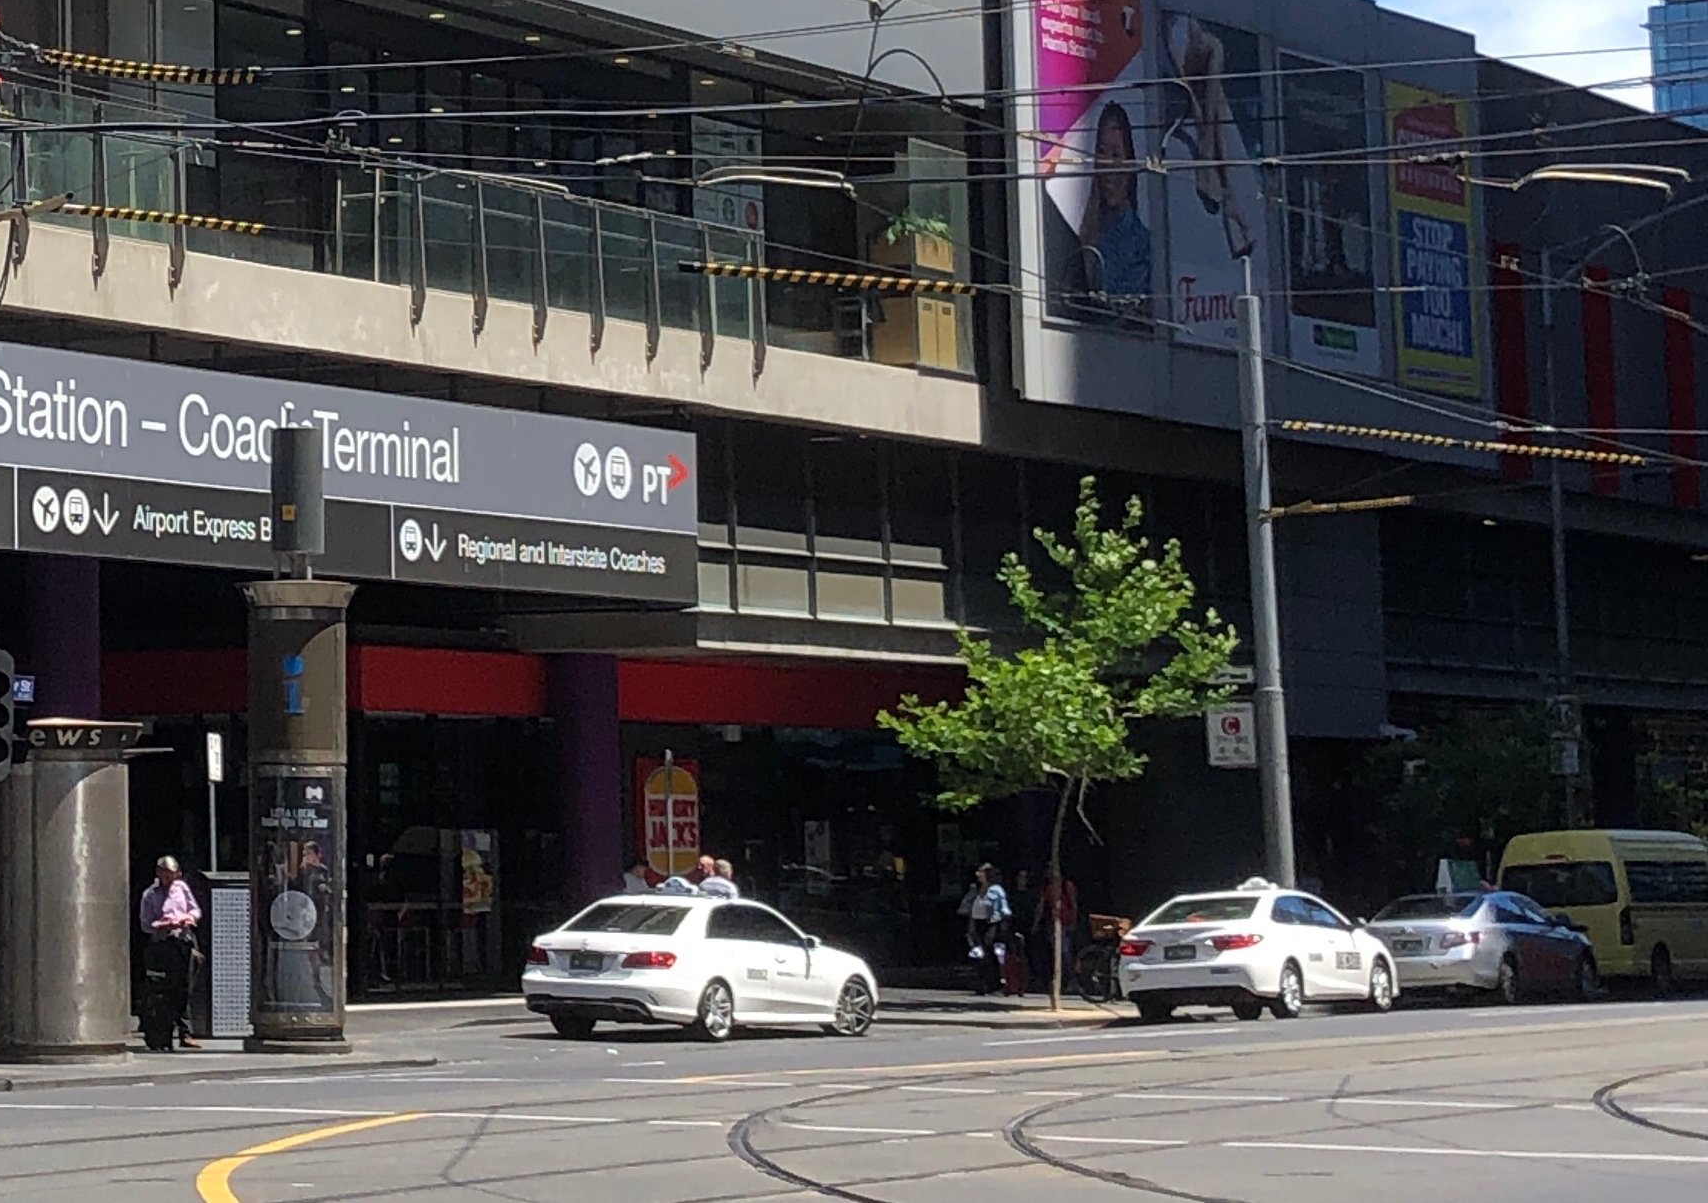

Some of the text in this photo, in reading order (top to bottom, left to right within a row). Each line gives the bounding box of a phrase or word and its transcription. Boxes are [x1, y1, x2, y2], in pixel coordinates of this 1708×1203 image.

[313, 409, 460, 483] Terminal
[133, 504, 190, 538] Airport
[193, 509, 256, 543] Express
[458, 533, 666, 574] Regional and Interstate Coaches
